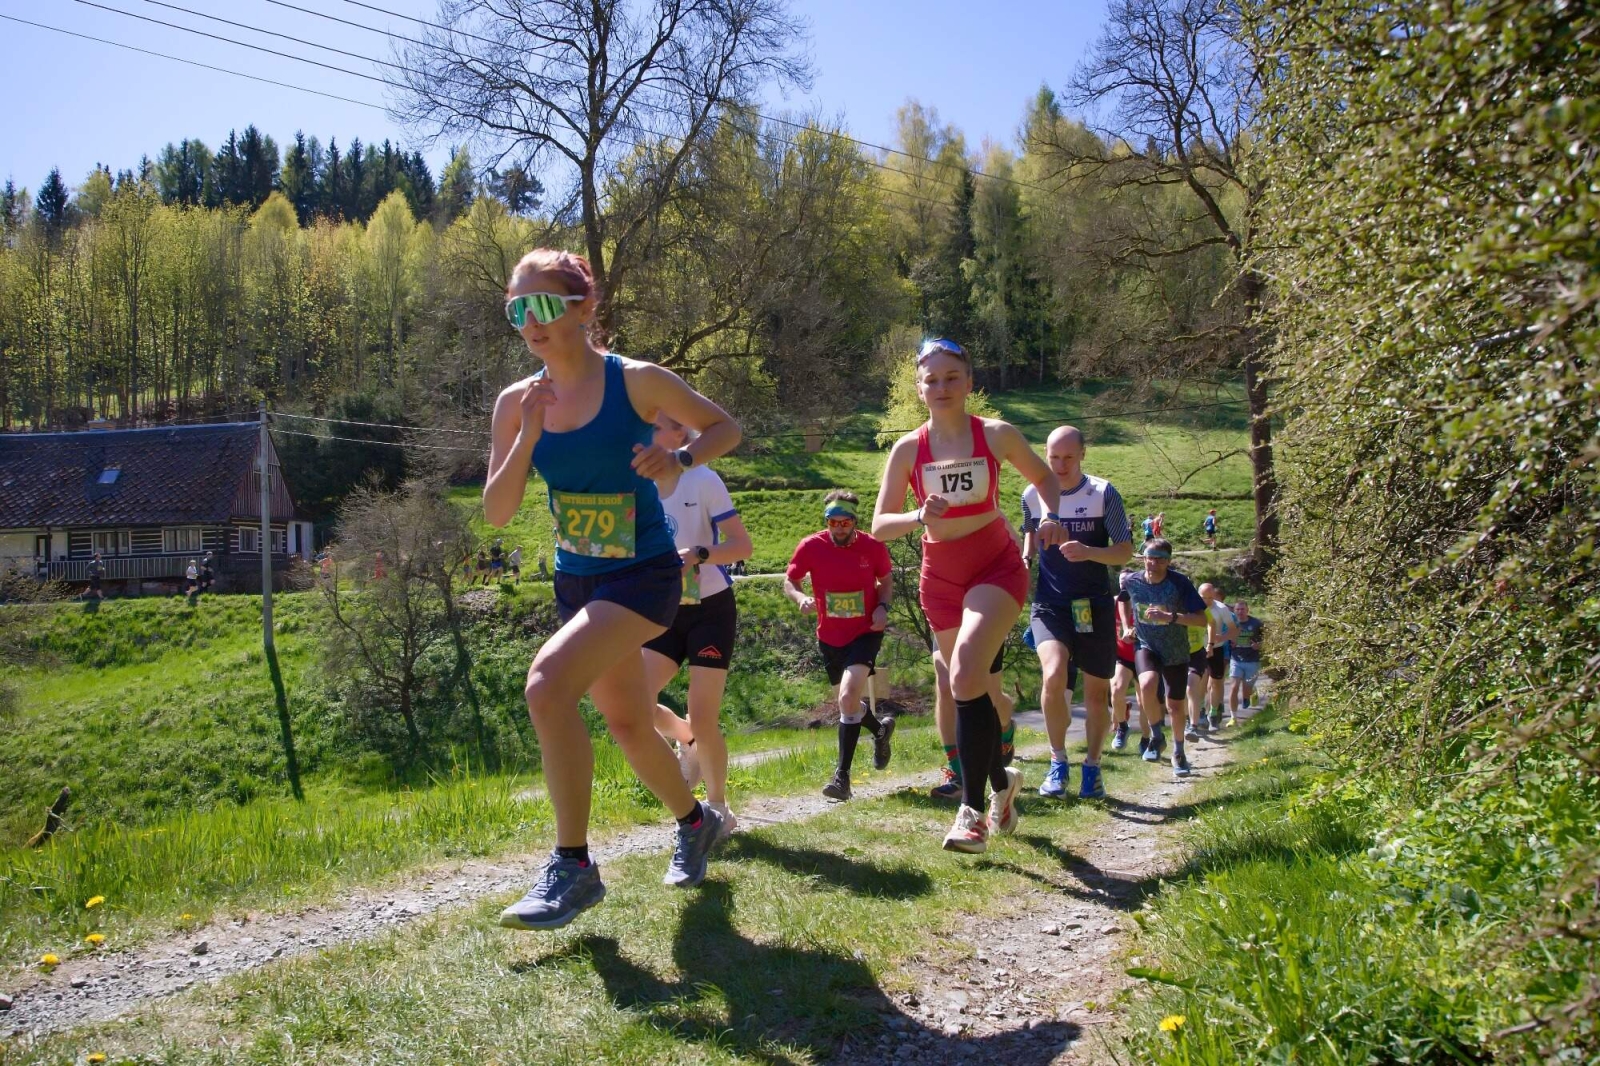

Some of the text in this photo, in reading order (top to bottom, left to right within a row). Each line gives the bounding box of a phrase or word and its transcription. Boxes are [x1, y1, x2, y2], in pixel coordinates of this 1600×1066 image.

[940, 471, 973, 493] 175
[566, 508, 615, 538] 279
[1070, 521, 1095, 532] TEAM
[834, 598, 857, 611] 241
